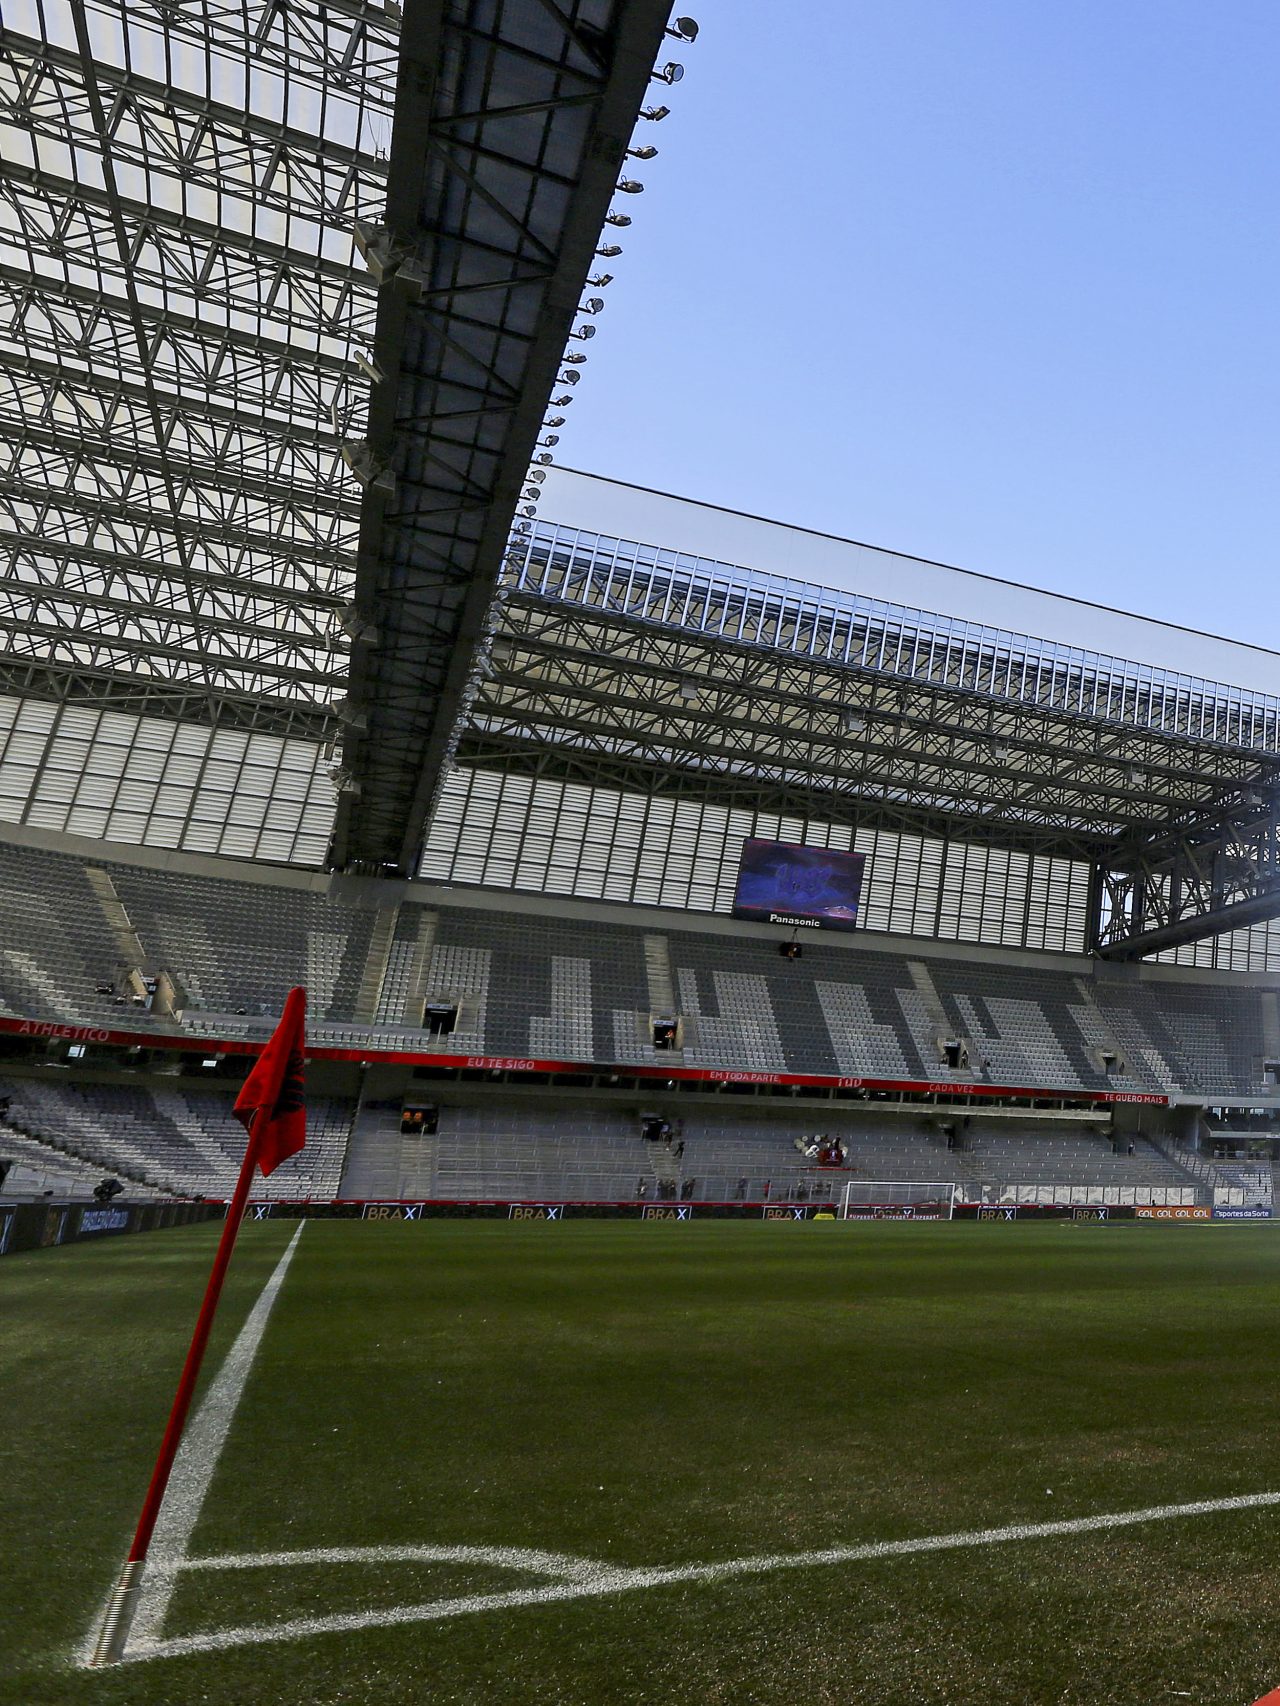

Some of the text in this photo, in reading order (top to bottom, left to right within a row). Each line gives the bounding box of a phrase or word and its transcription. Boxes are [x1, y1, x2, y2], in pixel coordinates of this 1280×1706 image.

[769, 913, 821, 927] Panasonic
[19, 1021, 110, 1042] ATHLETICO
[466, 1057, 535, 1070] EU TE SIGO
[709, 1071, 779, 1082] EM TODA PARTE
[929, 1083, 974, 1094] CADA VEZ
[1104, 1093, 1164, 1104] TE QUERO MAIS
[367, 1206, 417, 1220] BRAX
[513, 1207, 558, 1220] BRAX
[647, 1208, 687, 1220] BRAX
[767, 1208, 803, 1220] BRAX
[981, 1210, 1013, 1220] BRAX
[1076, 1210, 1106, 1220] BRAX
[1138, 1210, 1208, 1218] GOL GOL GOL GOL
